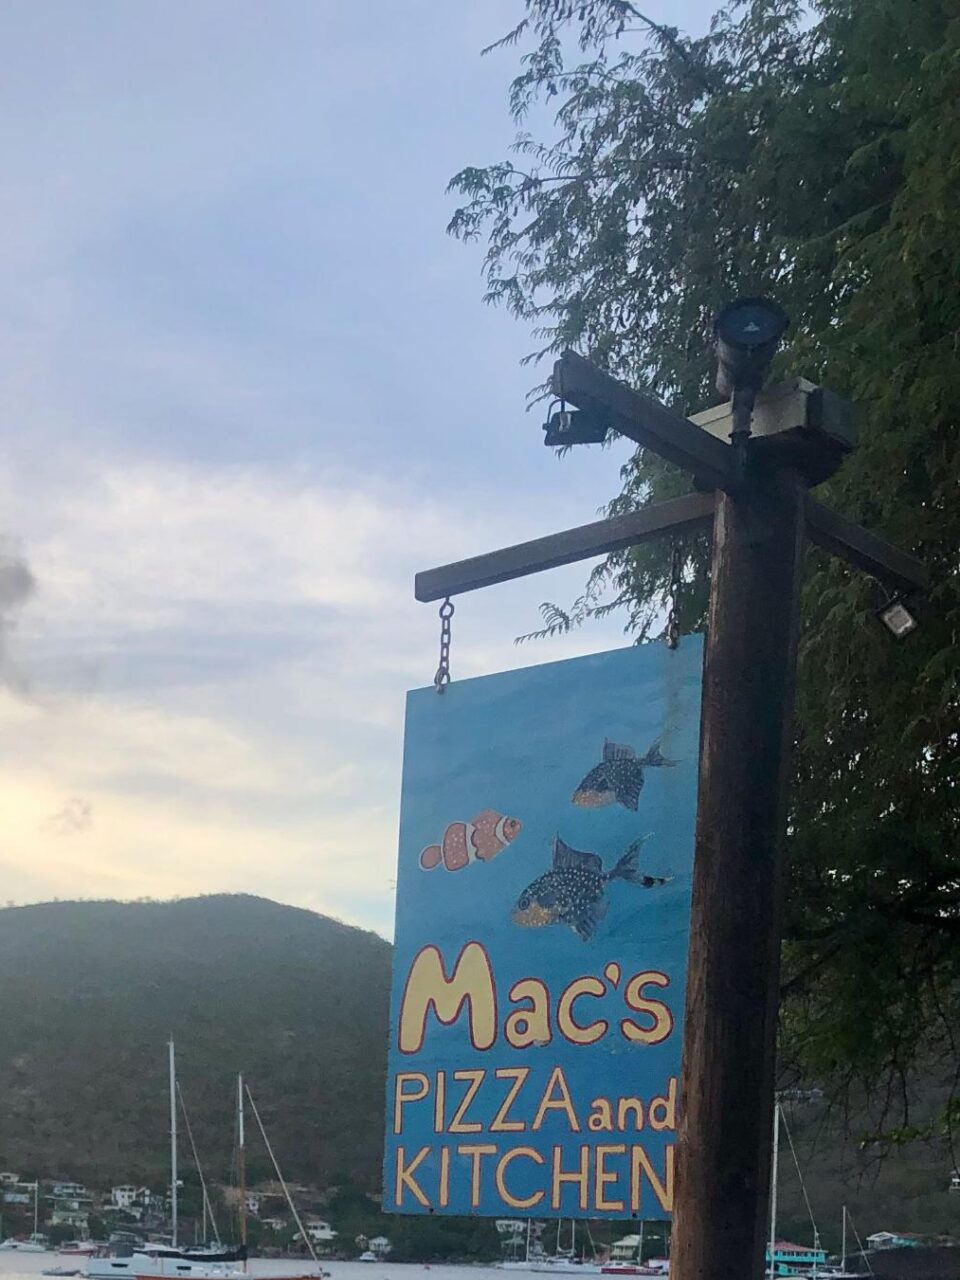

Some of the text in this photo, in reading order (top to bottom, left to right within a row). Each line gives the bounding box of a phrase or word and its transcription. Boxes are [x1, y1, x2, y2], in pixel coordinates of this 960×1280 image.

[397, 941, 674, 1054] Mac's
[393, 1066, 678, 1134] PIZZA and
[393, 1144, 675, 1212] KITCHEN
